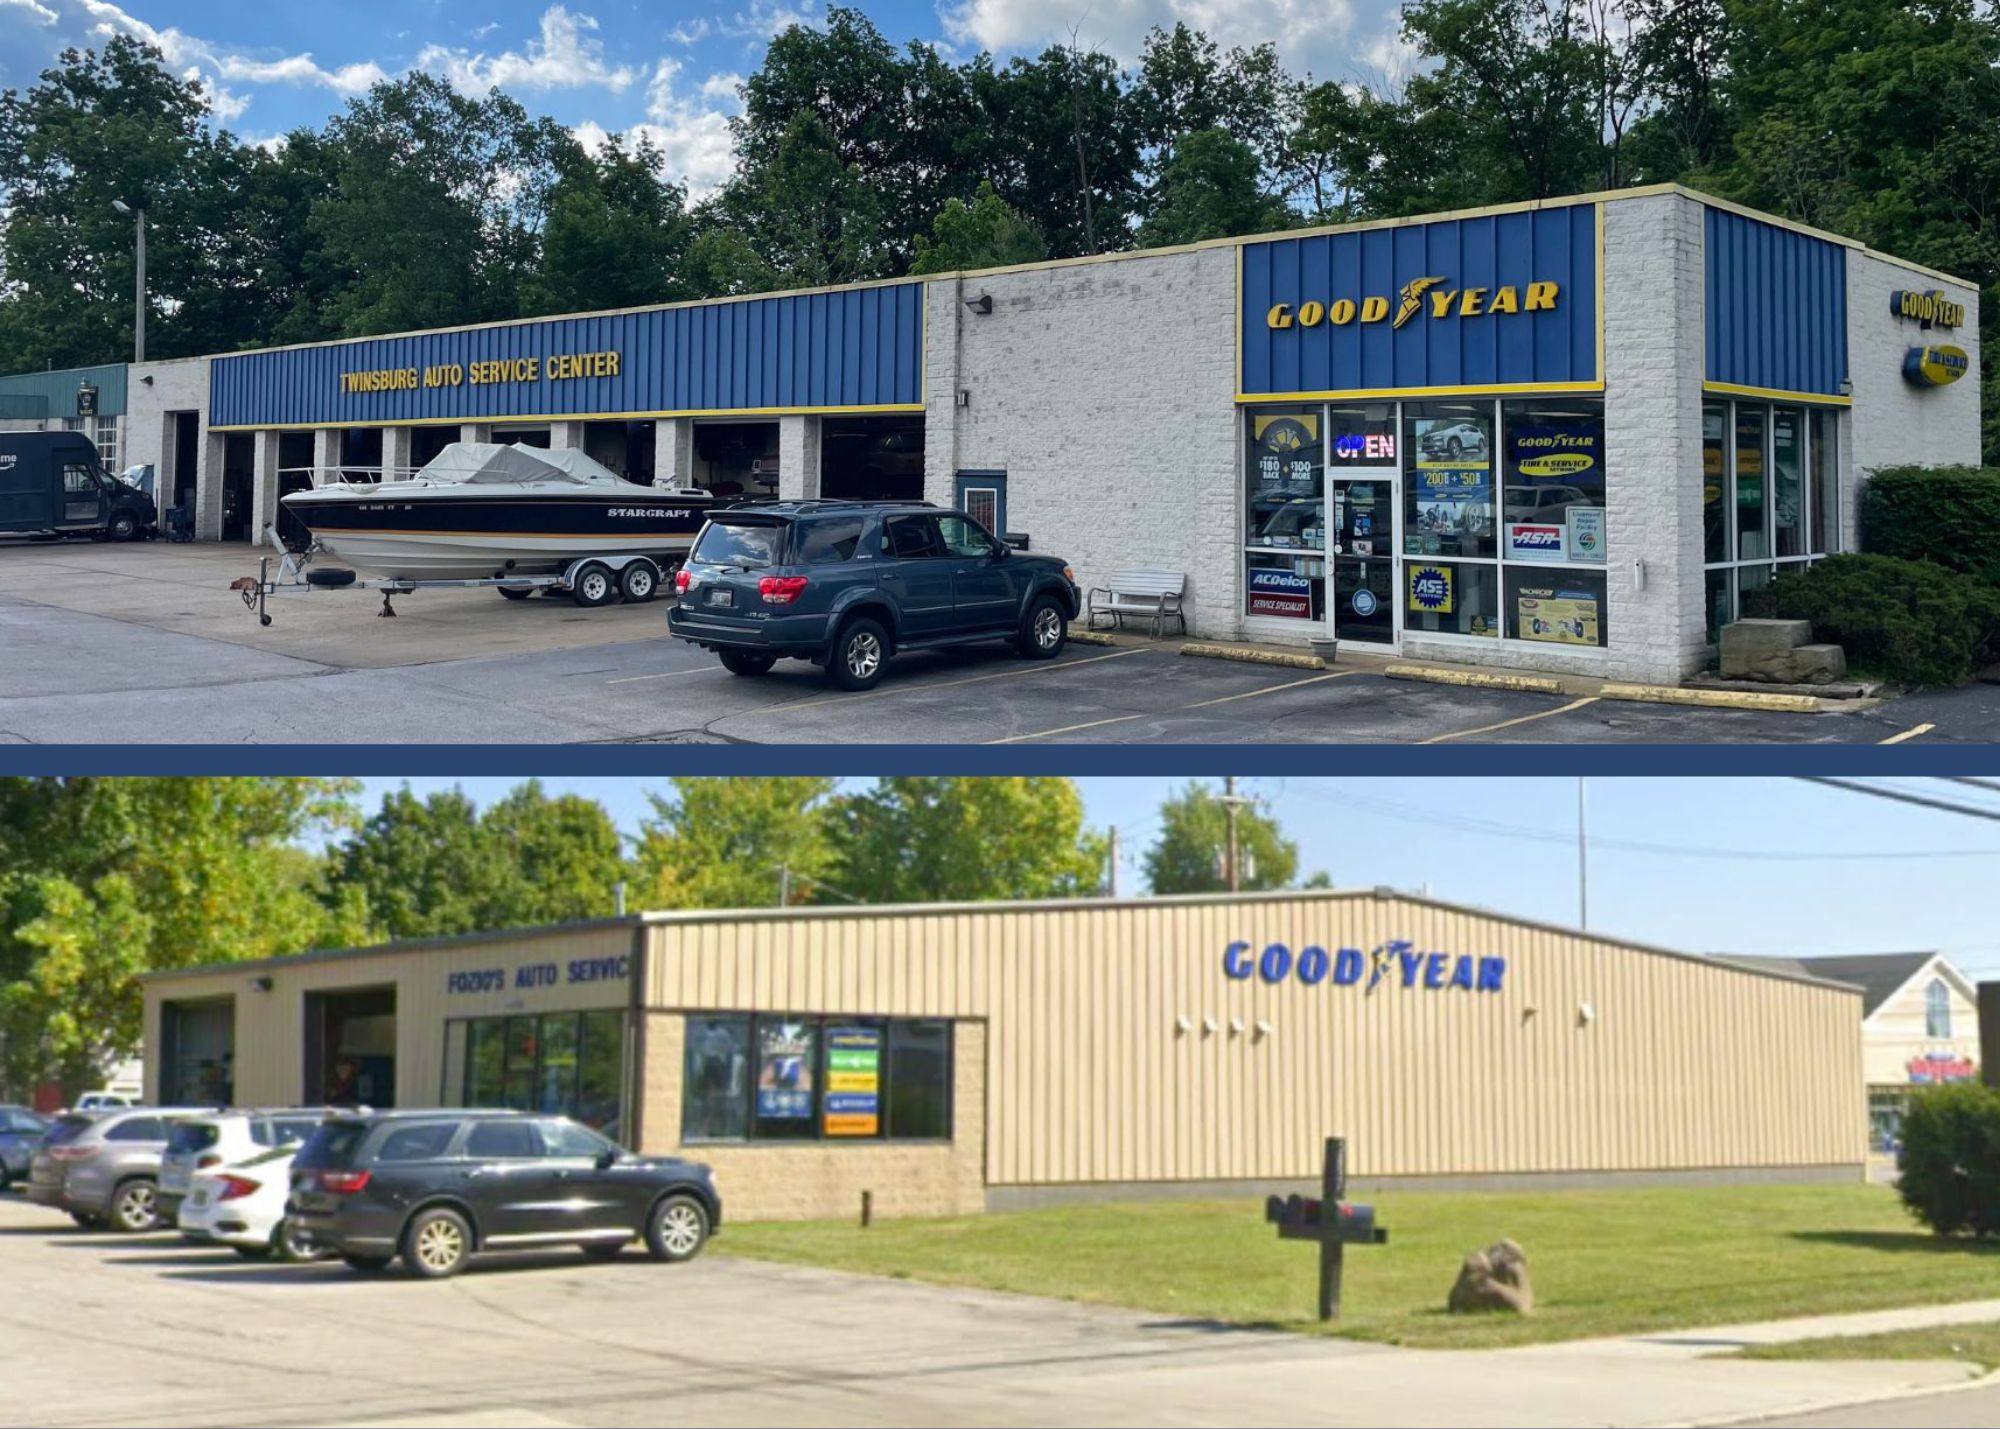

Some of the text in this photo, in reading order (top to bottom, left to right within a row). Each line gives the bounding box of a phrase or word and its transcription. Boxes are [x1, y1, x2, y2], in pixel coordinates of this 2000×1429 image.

[340, 351, 620, 392] TWINSBURG AUTO SERVICE CENTER
[1335, 434, 1394, 458] OPEN
[1290, 461, 1311, 472] $100
[1550, 459, 1588, 468] SERVICE
[608, 508, 691, 518] STARCRAFT
[1253, 574, 1309, 587] ACDelco
[1416, 579, 1443, 594] ASE
[1253, 599, 1307, 612] SERVICE SPECIALIST
[514, 962, 557, 988] AUTO
